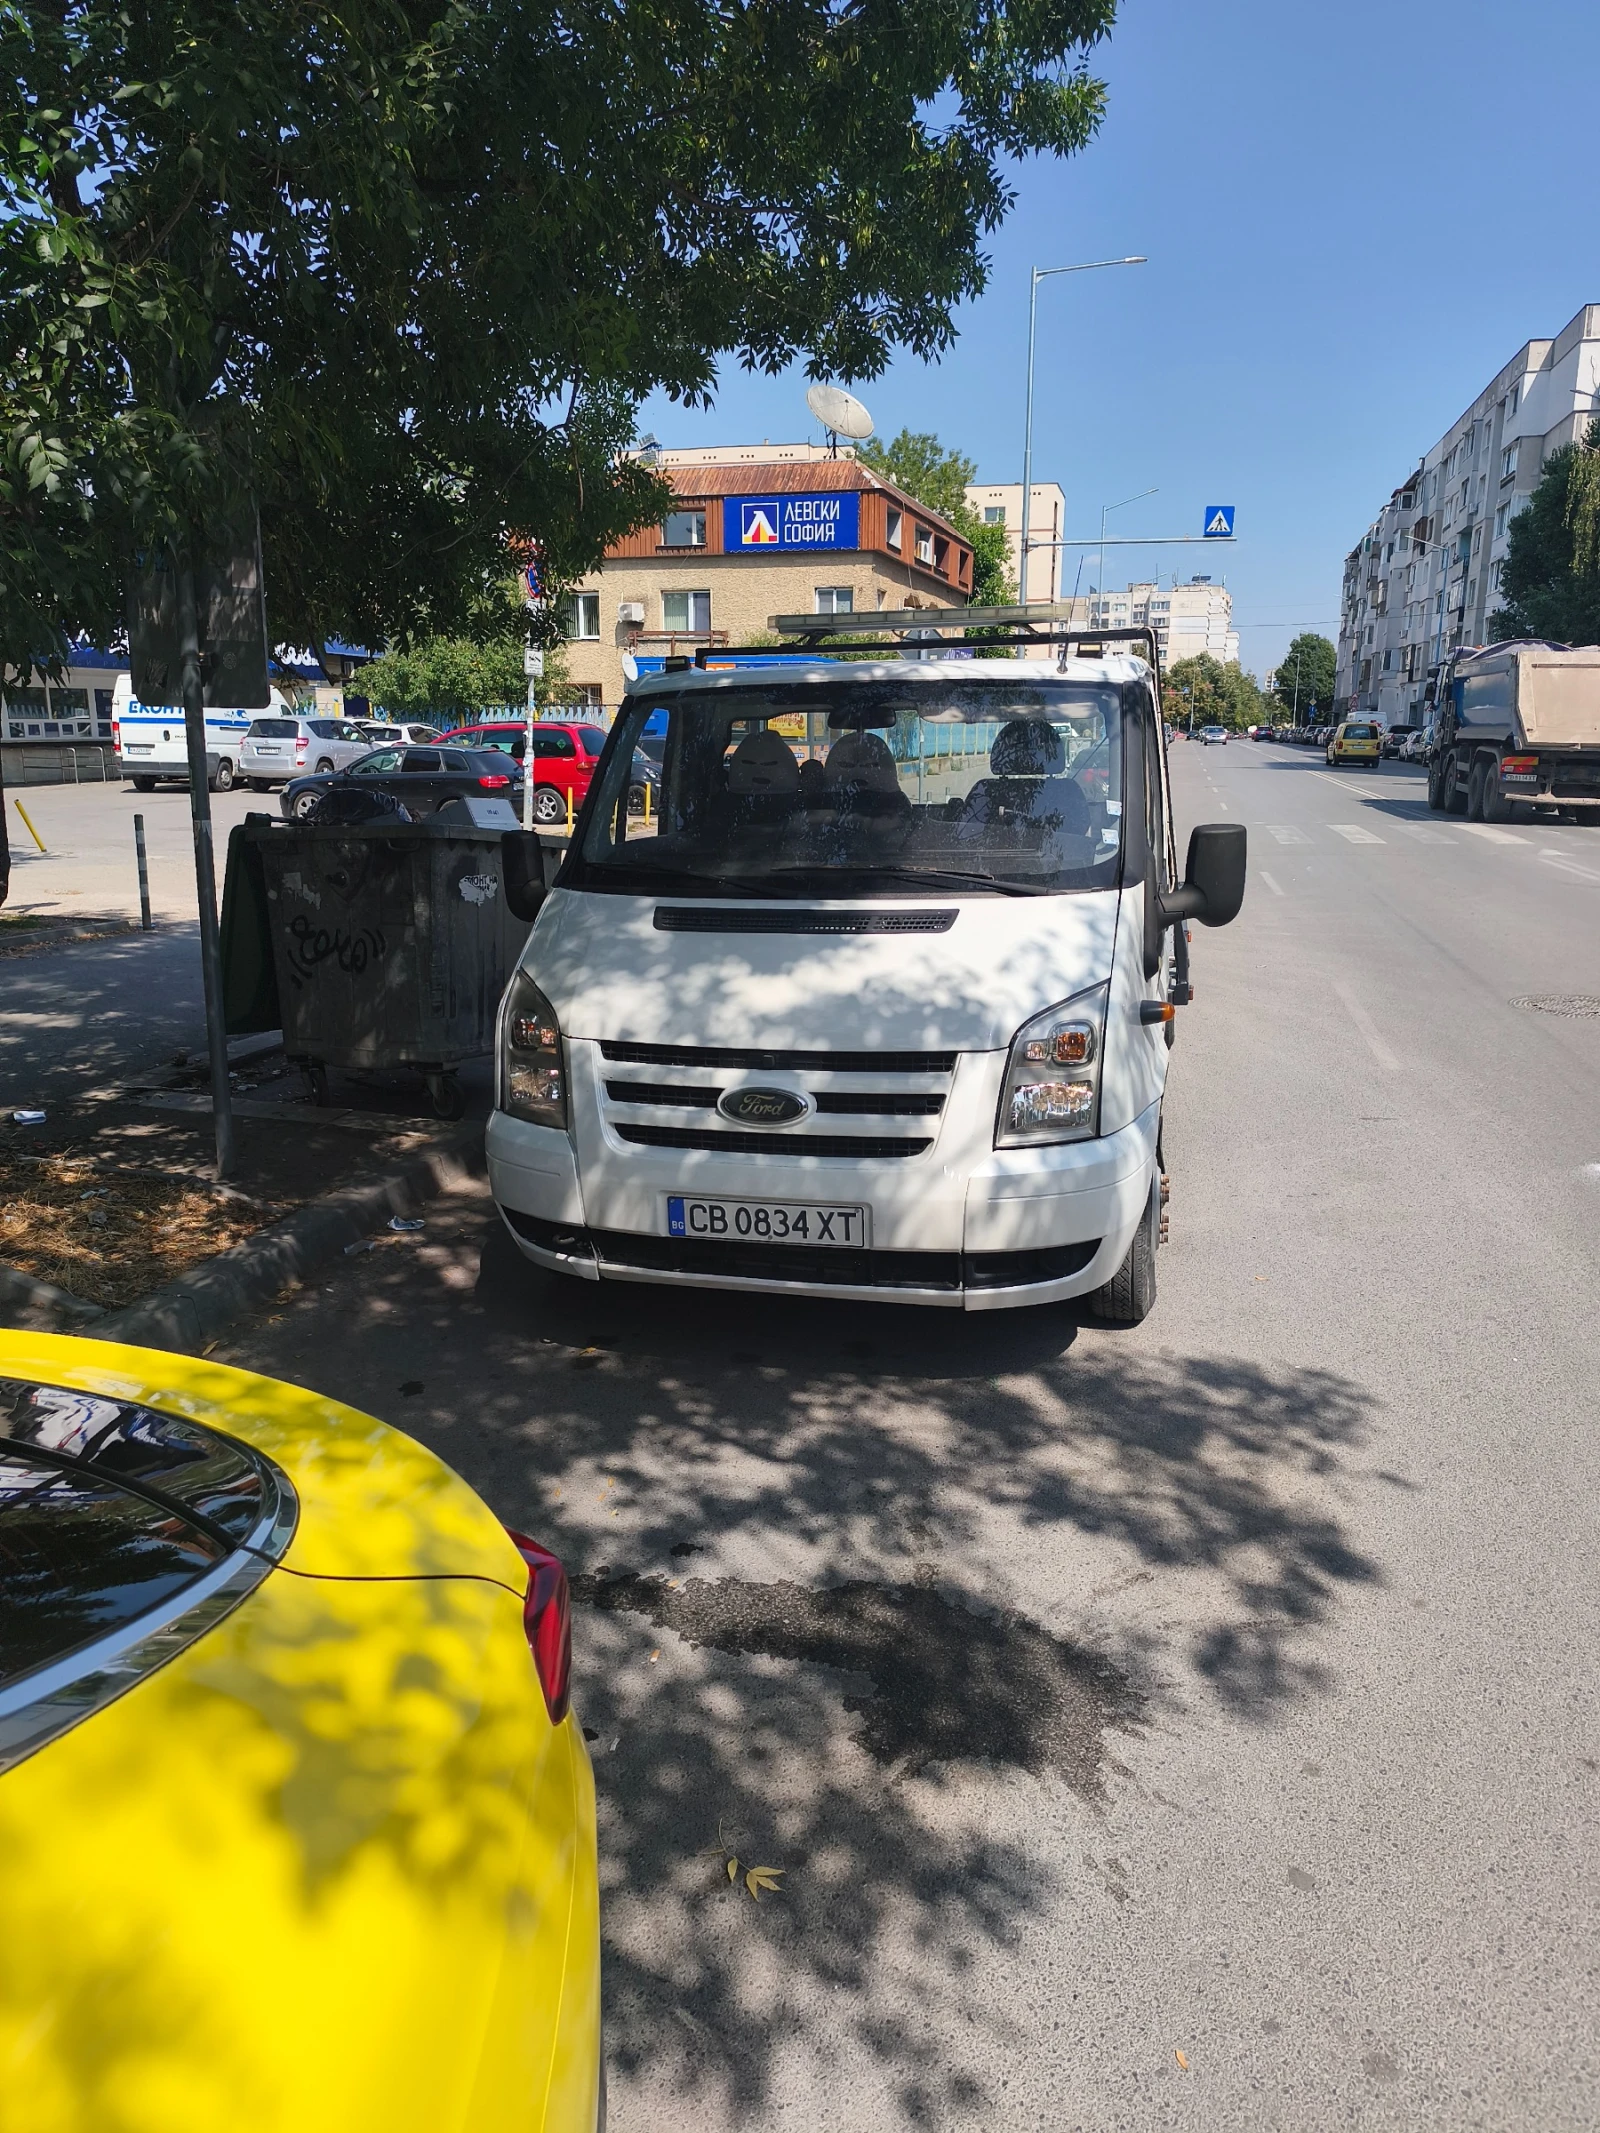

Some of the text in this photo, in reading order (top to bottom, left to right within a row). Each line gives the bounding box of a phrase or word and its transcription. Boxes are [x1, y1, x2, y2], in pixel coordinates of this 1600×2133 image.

[784, 500, 840, 521] ЛЕВСКИ
[784, 523, 835, 542] СОФИЯ
[739, 1094, 785, 1115] Ford
[671, 1204, 857, 1242] BG CB 0834 XT
